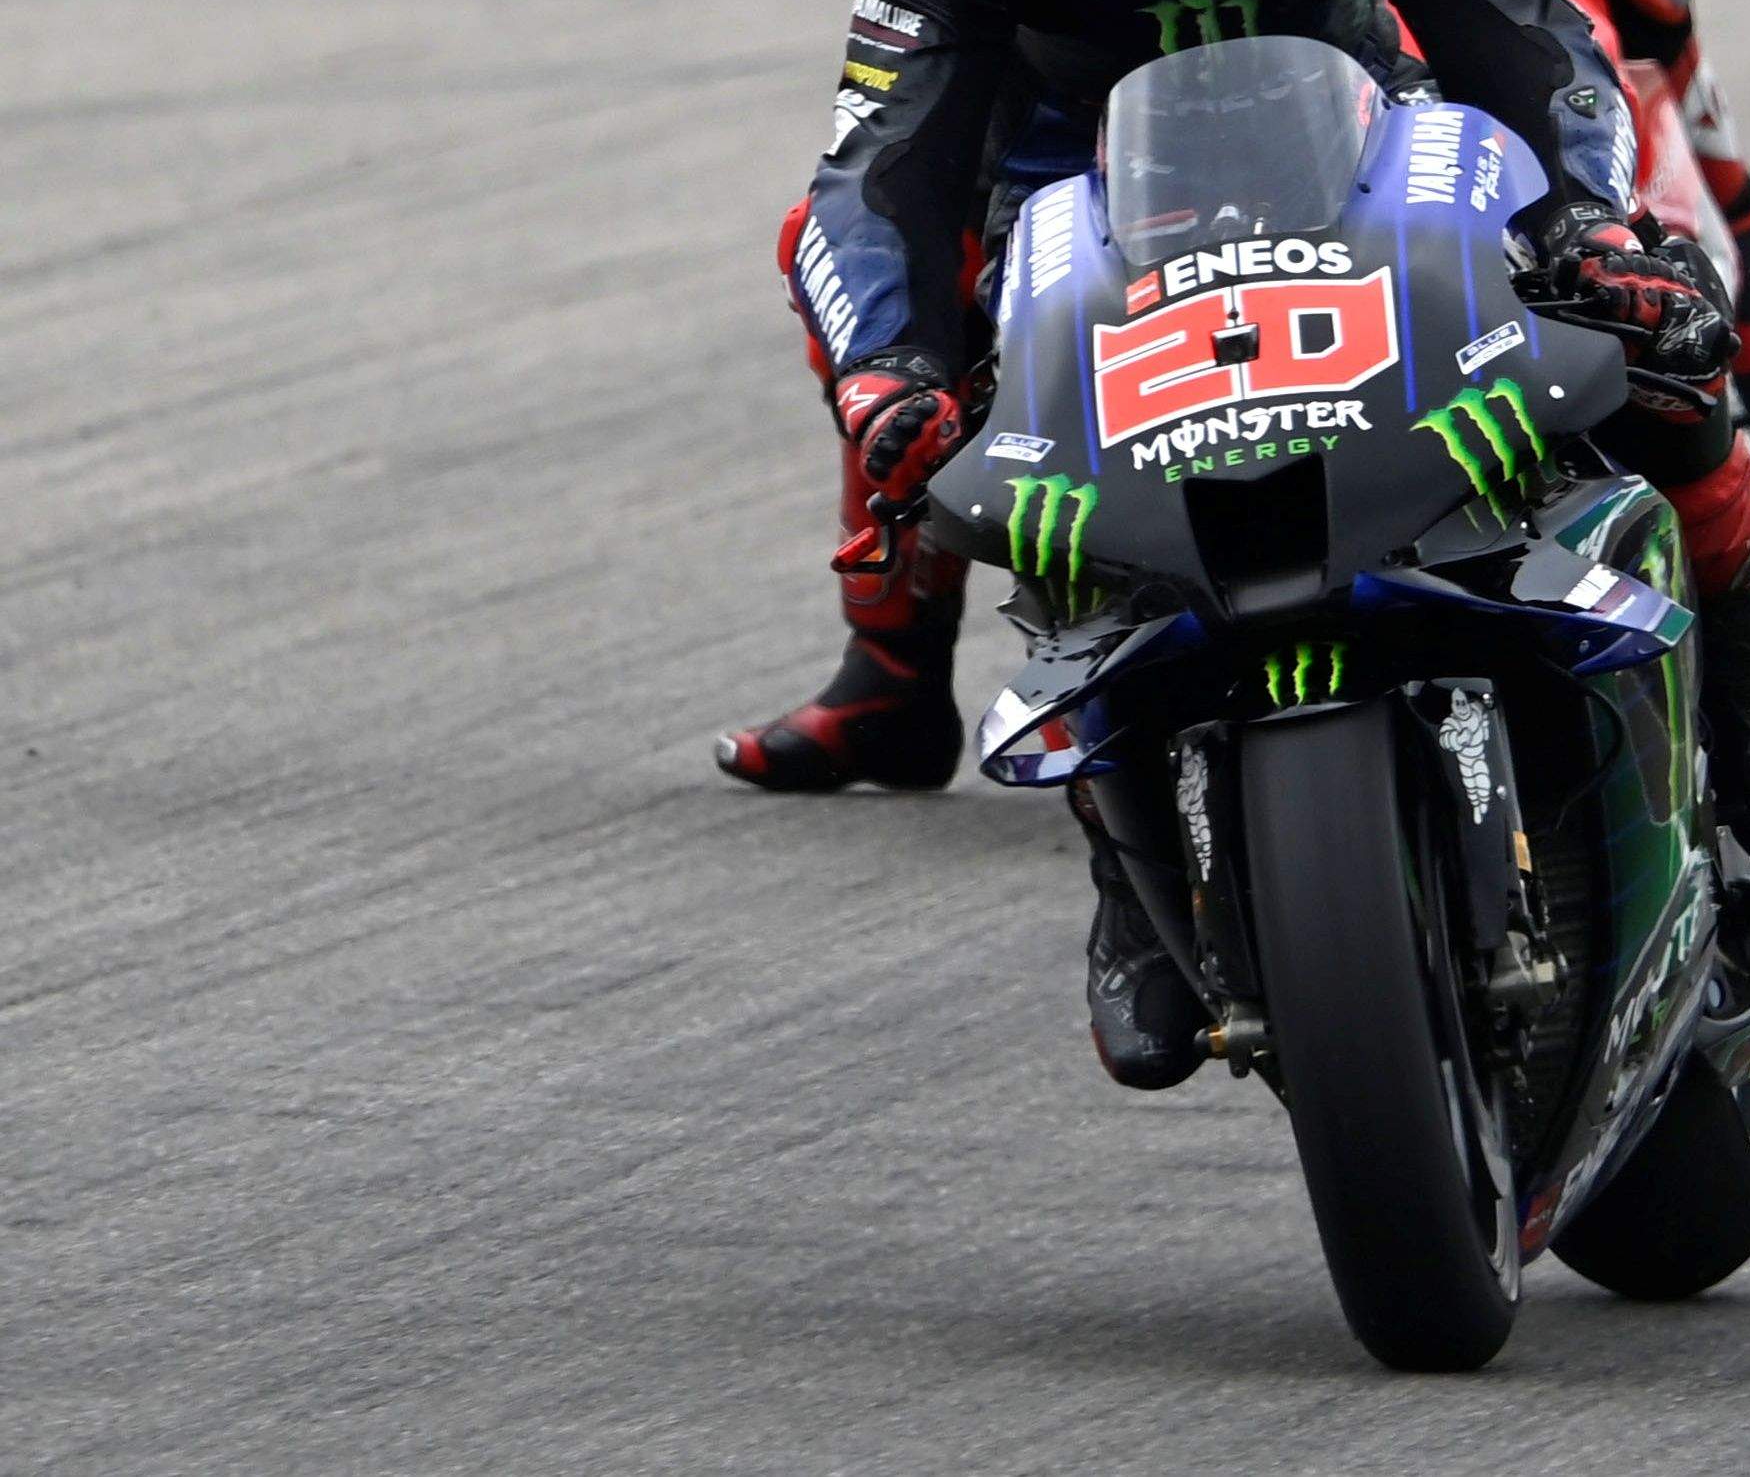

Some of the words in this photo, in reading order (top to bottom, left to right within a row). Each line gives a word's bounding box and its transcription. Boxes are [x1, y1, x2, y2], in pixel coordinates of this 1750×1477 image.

[1406, 110, 1465, 205] YAMAHA
[1028, 183, 1075, 298] YAMAHA
[1163, 237, 1353, 298] ENEOS
[795, 215, 859, 366] YAMAHA
[1163, 434, 1340, 483] ENERGY
